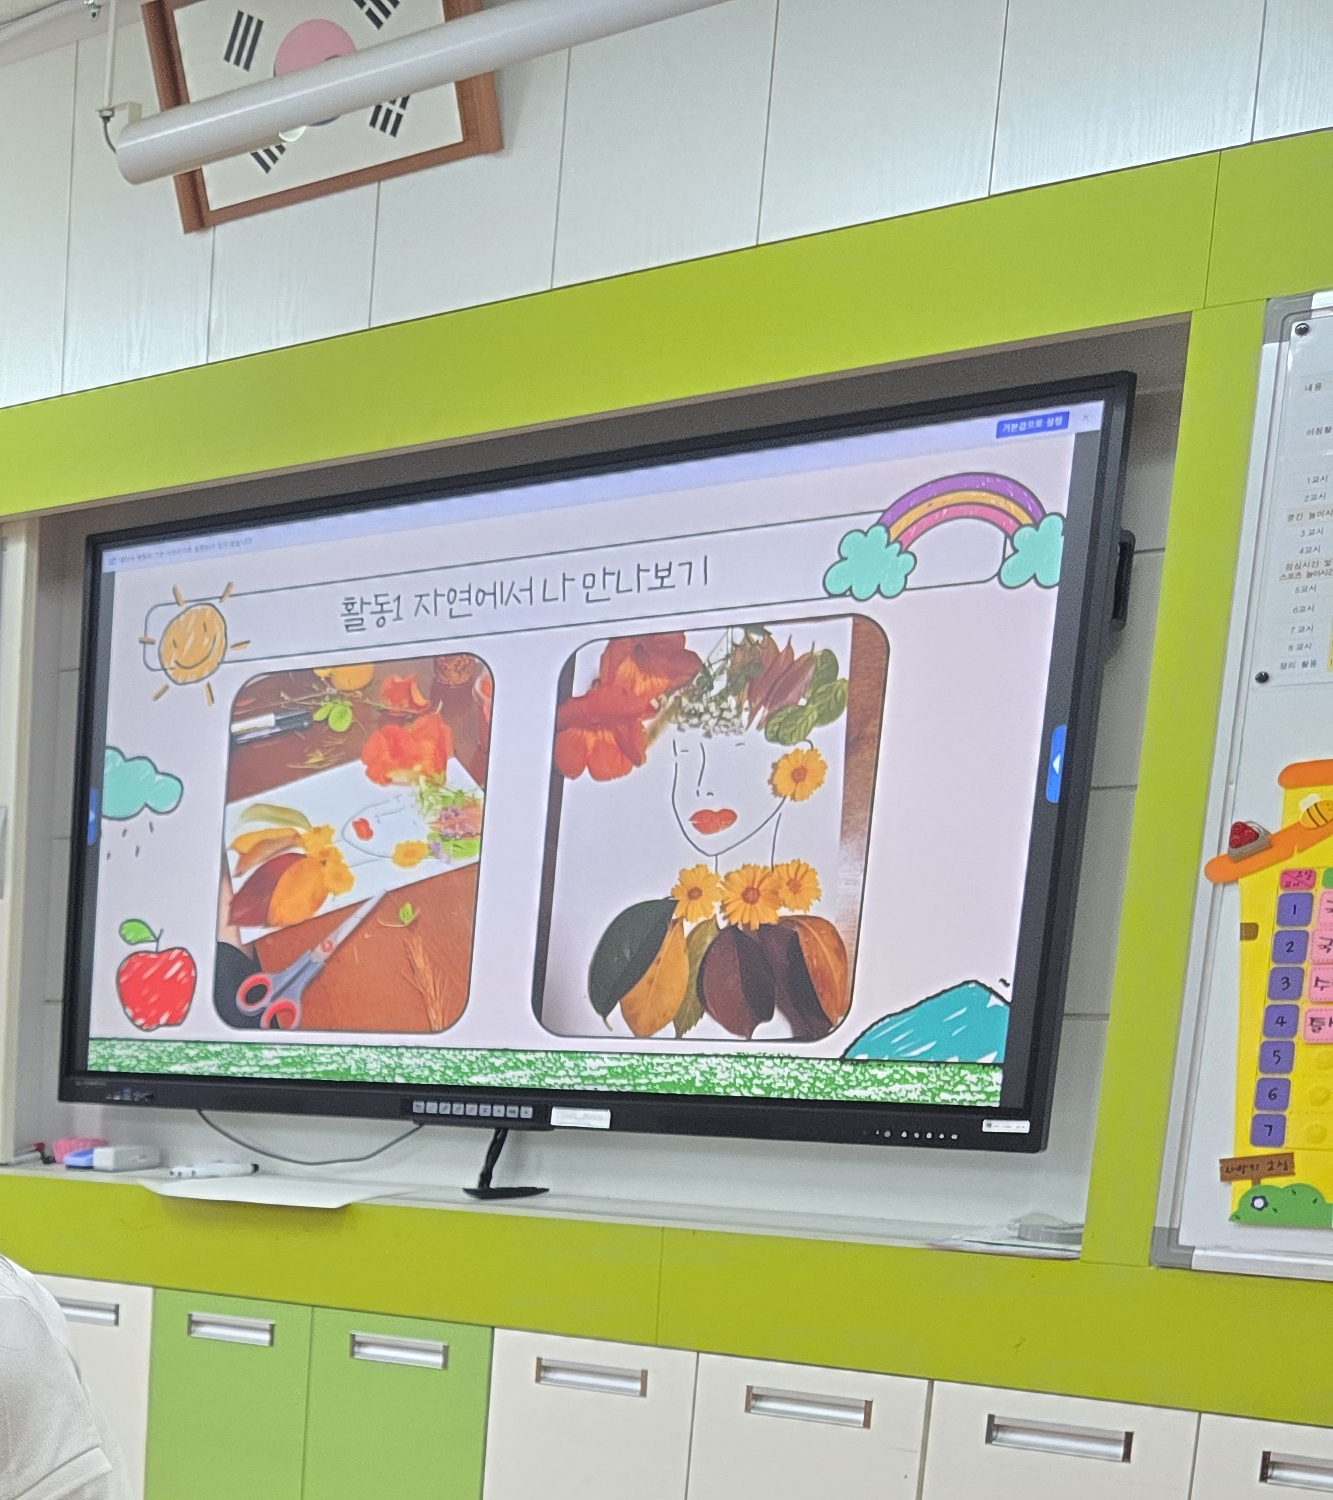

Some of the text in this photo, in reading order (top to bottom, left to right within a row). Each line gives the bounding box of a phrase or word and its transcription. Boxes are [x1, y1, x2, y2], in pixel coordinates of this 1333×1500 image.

[339, 554, 709, 633] 활동1 자연에서 나 만나보기
[1292, 903, 1297, 916] 1
[1285, 941, 1294, 953] 2
[1280, 976, 1291, 991] 3
[1274, 1015, 1288, 1027] 4
[1272, 1049, 1282, 1065] 5
[1267, 1087, 1278, 1101] 6
[1263, 1124, 1273, 1137] 7
